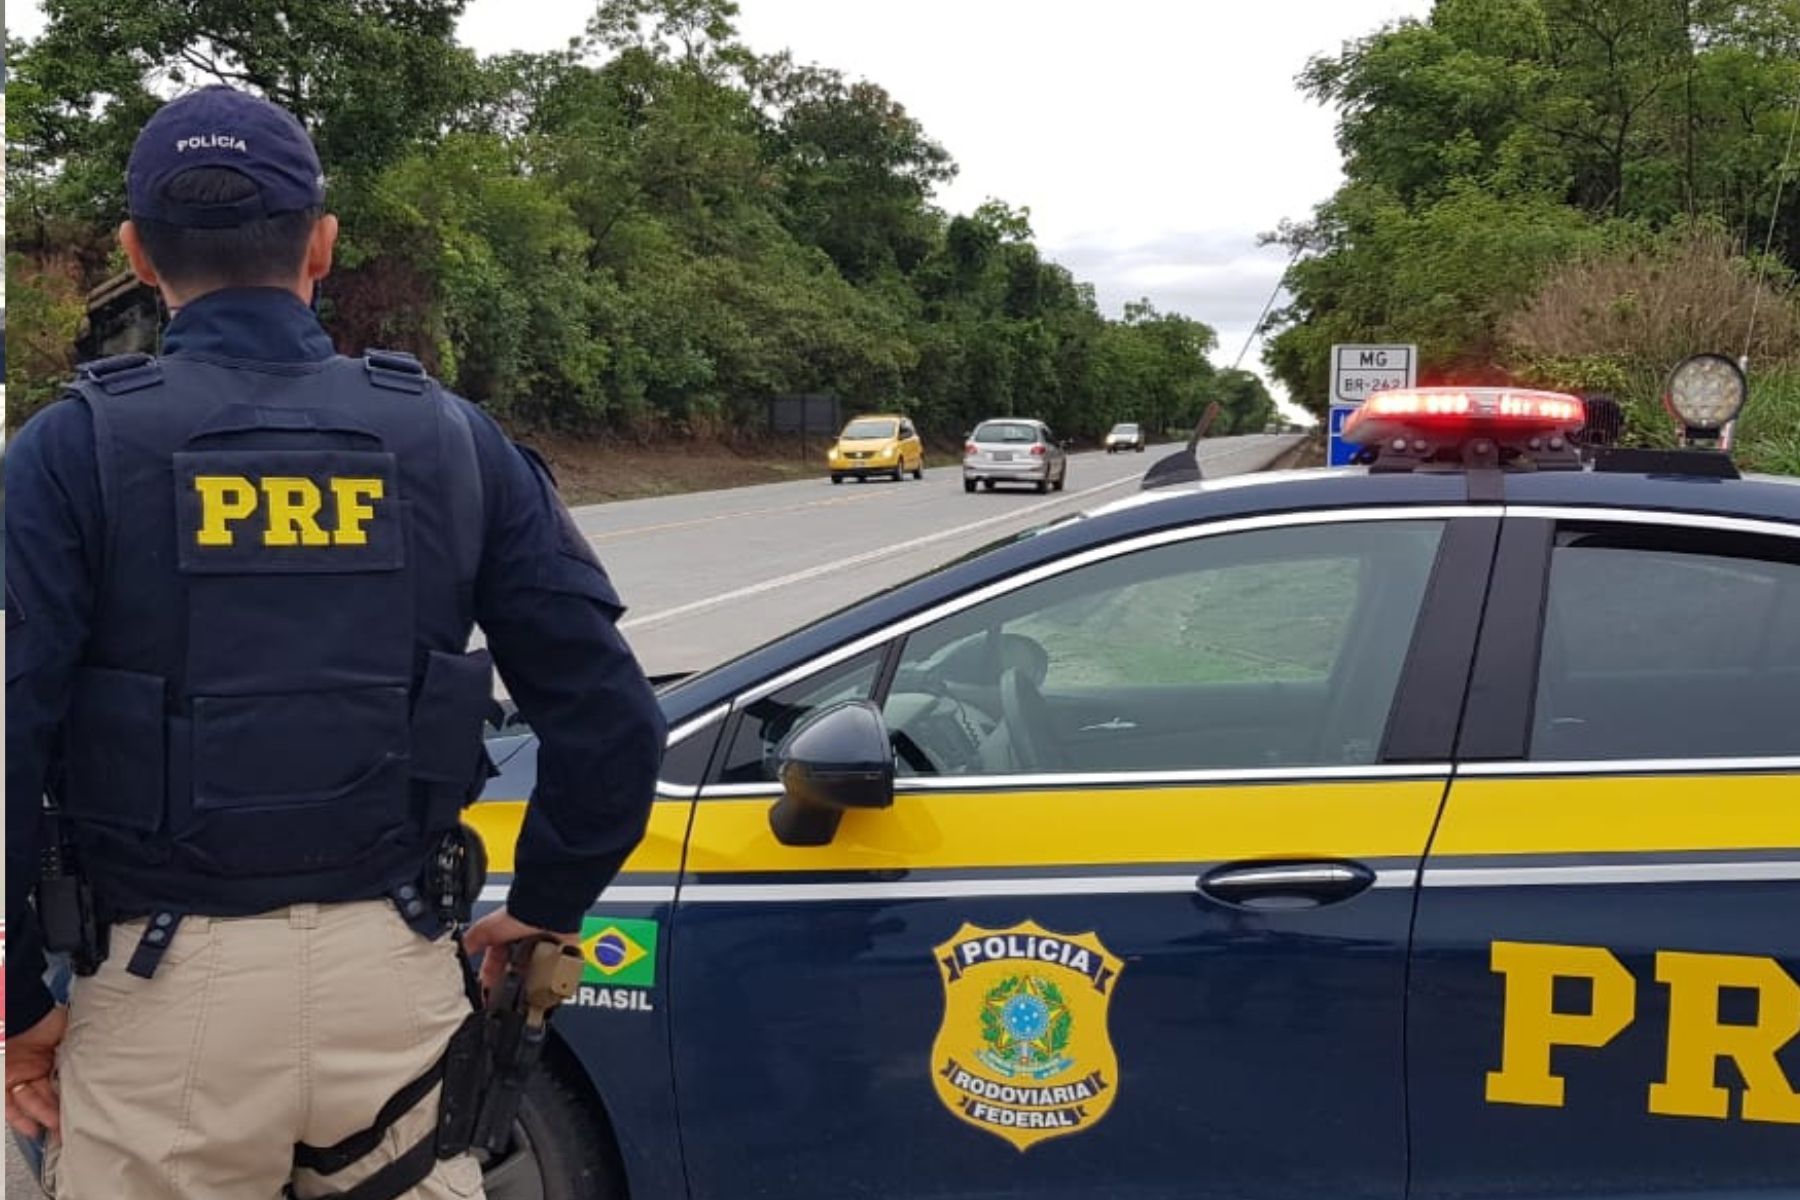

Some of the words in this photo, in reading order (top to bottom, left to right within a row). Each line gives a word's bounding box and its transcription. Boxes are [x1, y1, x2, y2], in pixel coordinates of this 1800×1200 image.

[1359, 352, 1388, 367] MG
[195, 476, 384, 546] PRF
[1485, 940, 1800, 1124] PR
[973, 1103, 1073, 1128] FEDERAL
